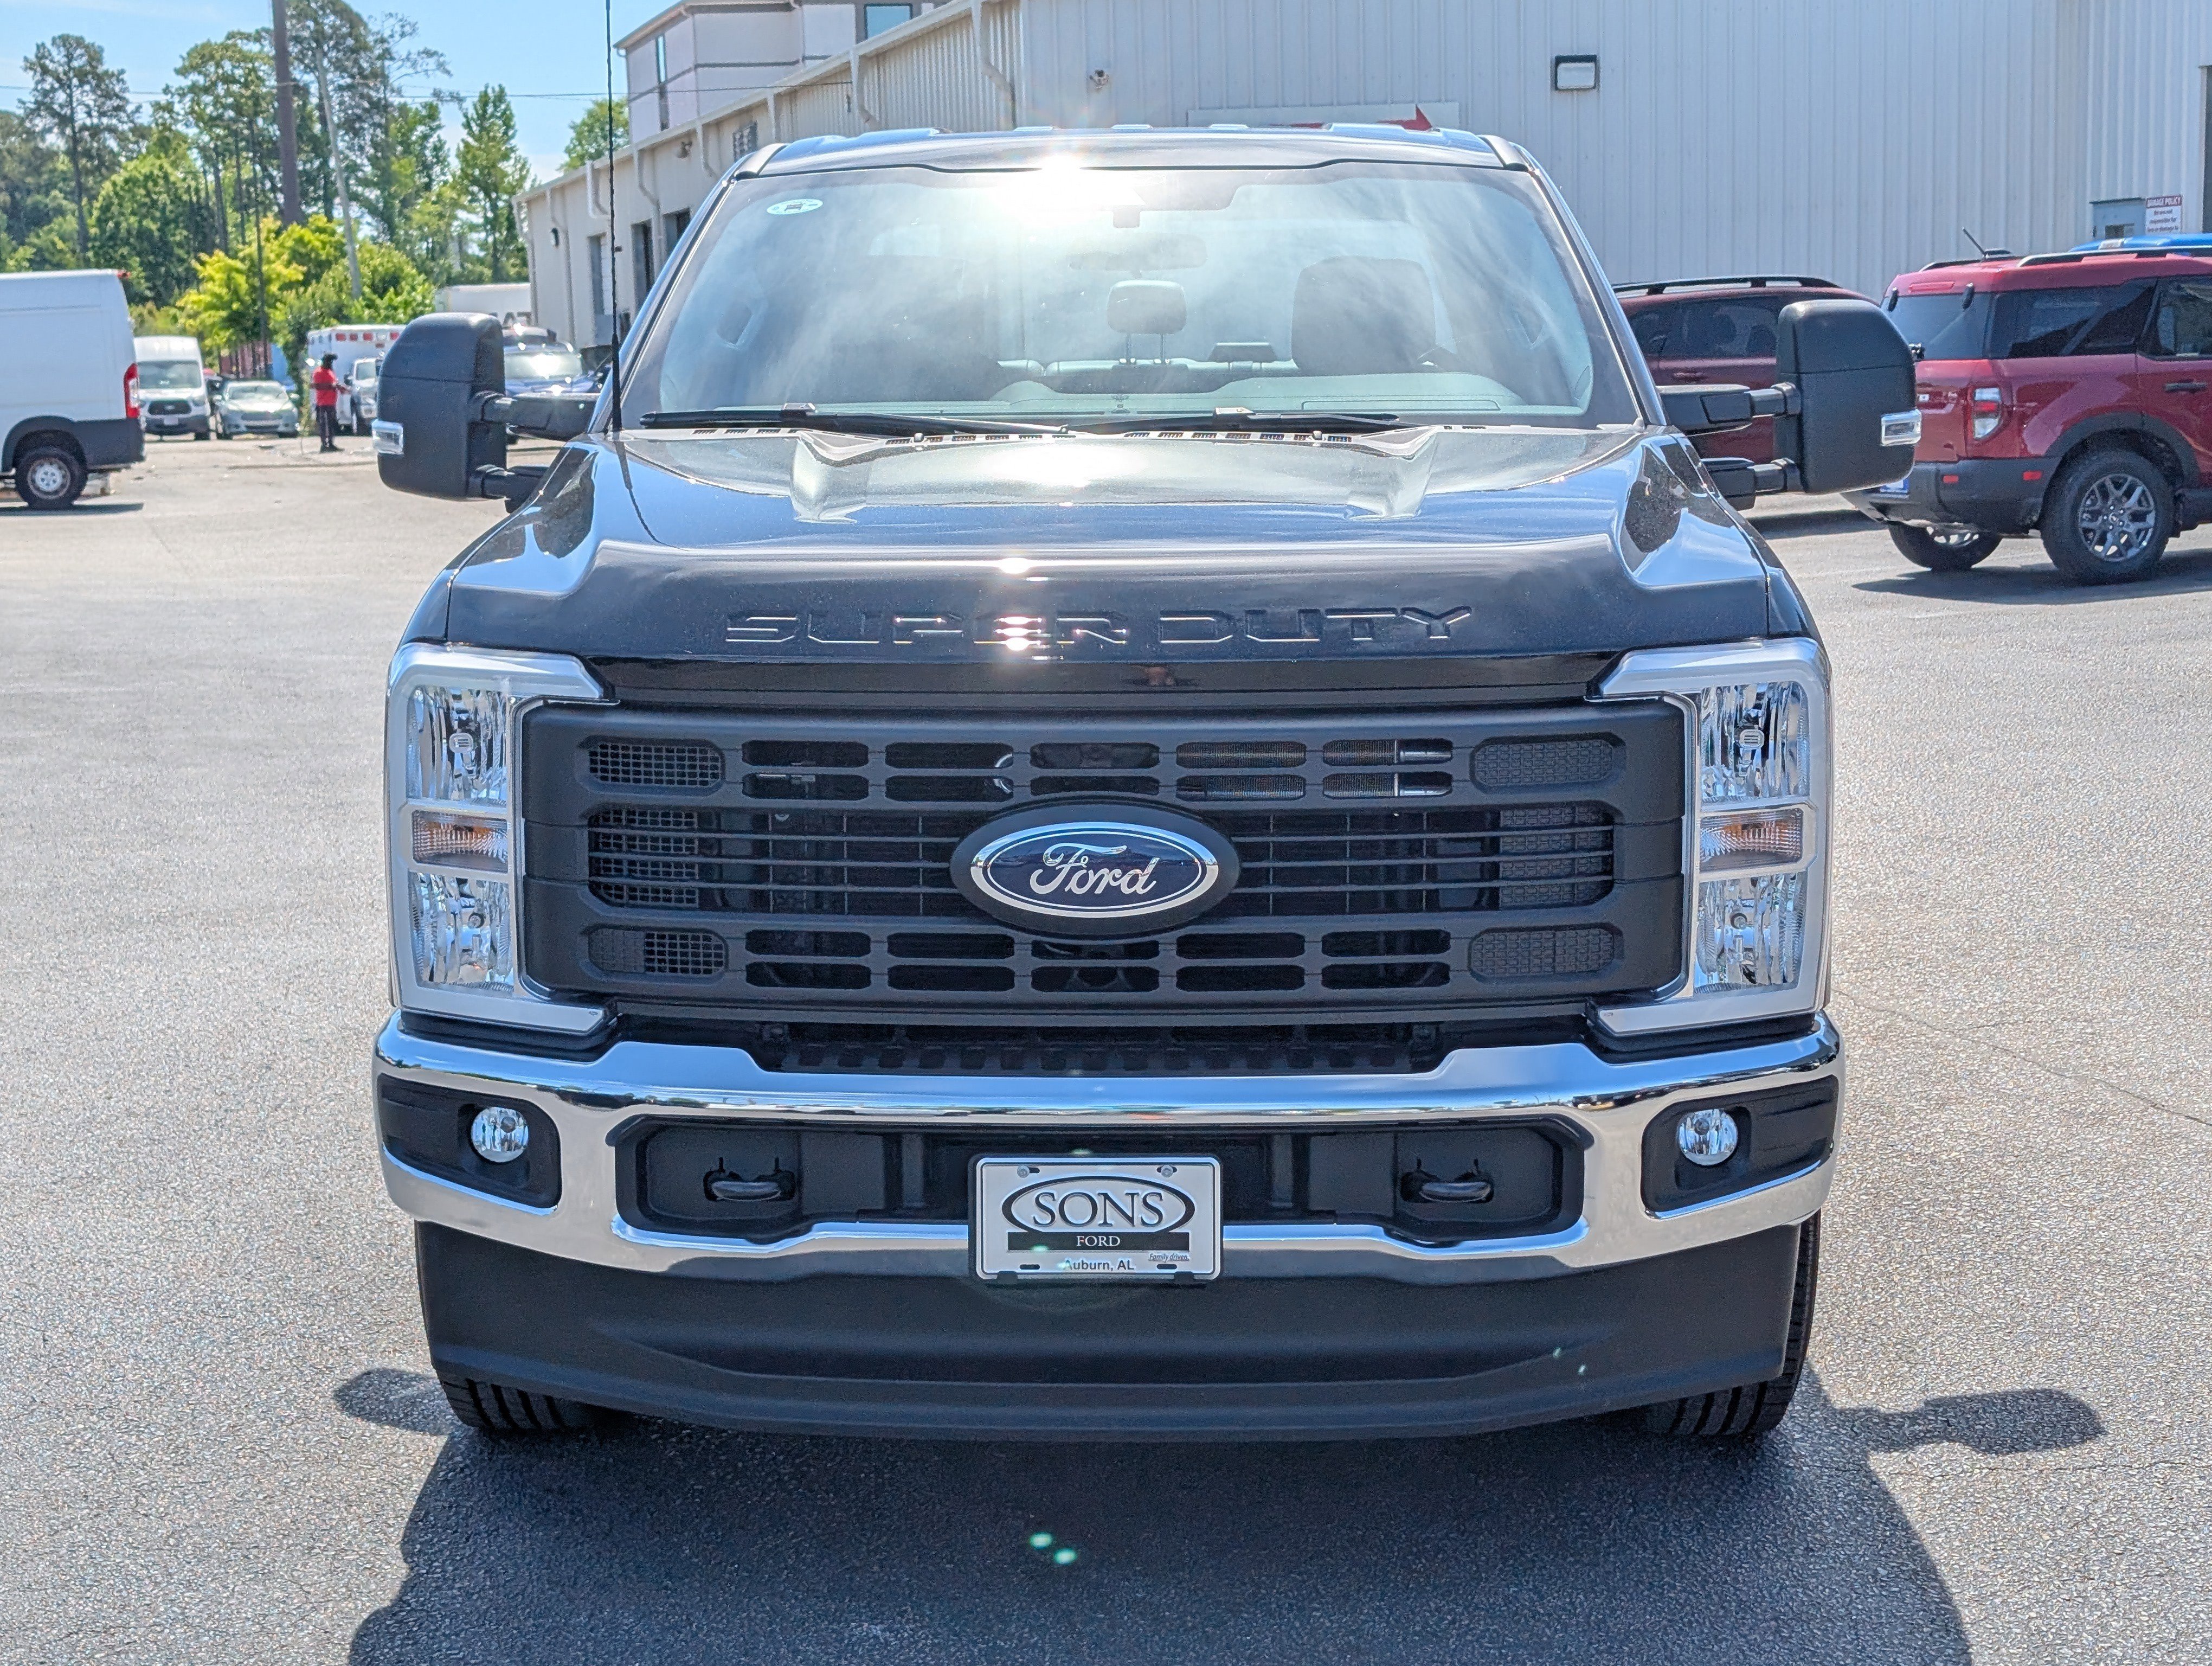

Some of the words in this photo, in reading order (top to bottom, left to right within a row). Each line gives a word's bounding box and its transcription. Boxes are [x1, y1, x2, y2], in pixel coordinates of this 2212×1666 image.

[725, 610, 1127, 645] SUPER
[1159, 606, 1472, 644] DUTY
[1030, 842, 1160, 894] Ford
[1033, 1192, 1163, 1227] SONS
[1076, 1235, 1121, 1246] FORD
[1065, 1259, 1114, 1272] Auburn,
[1117, 1259, 1134, 1271] AL
[1149, 1253, 1168, 1263] Family
